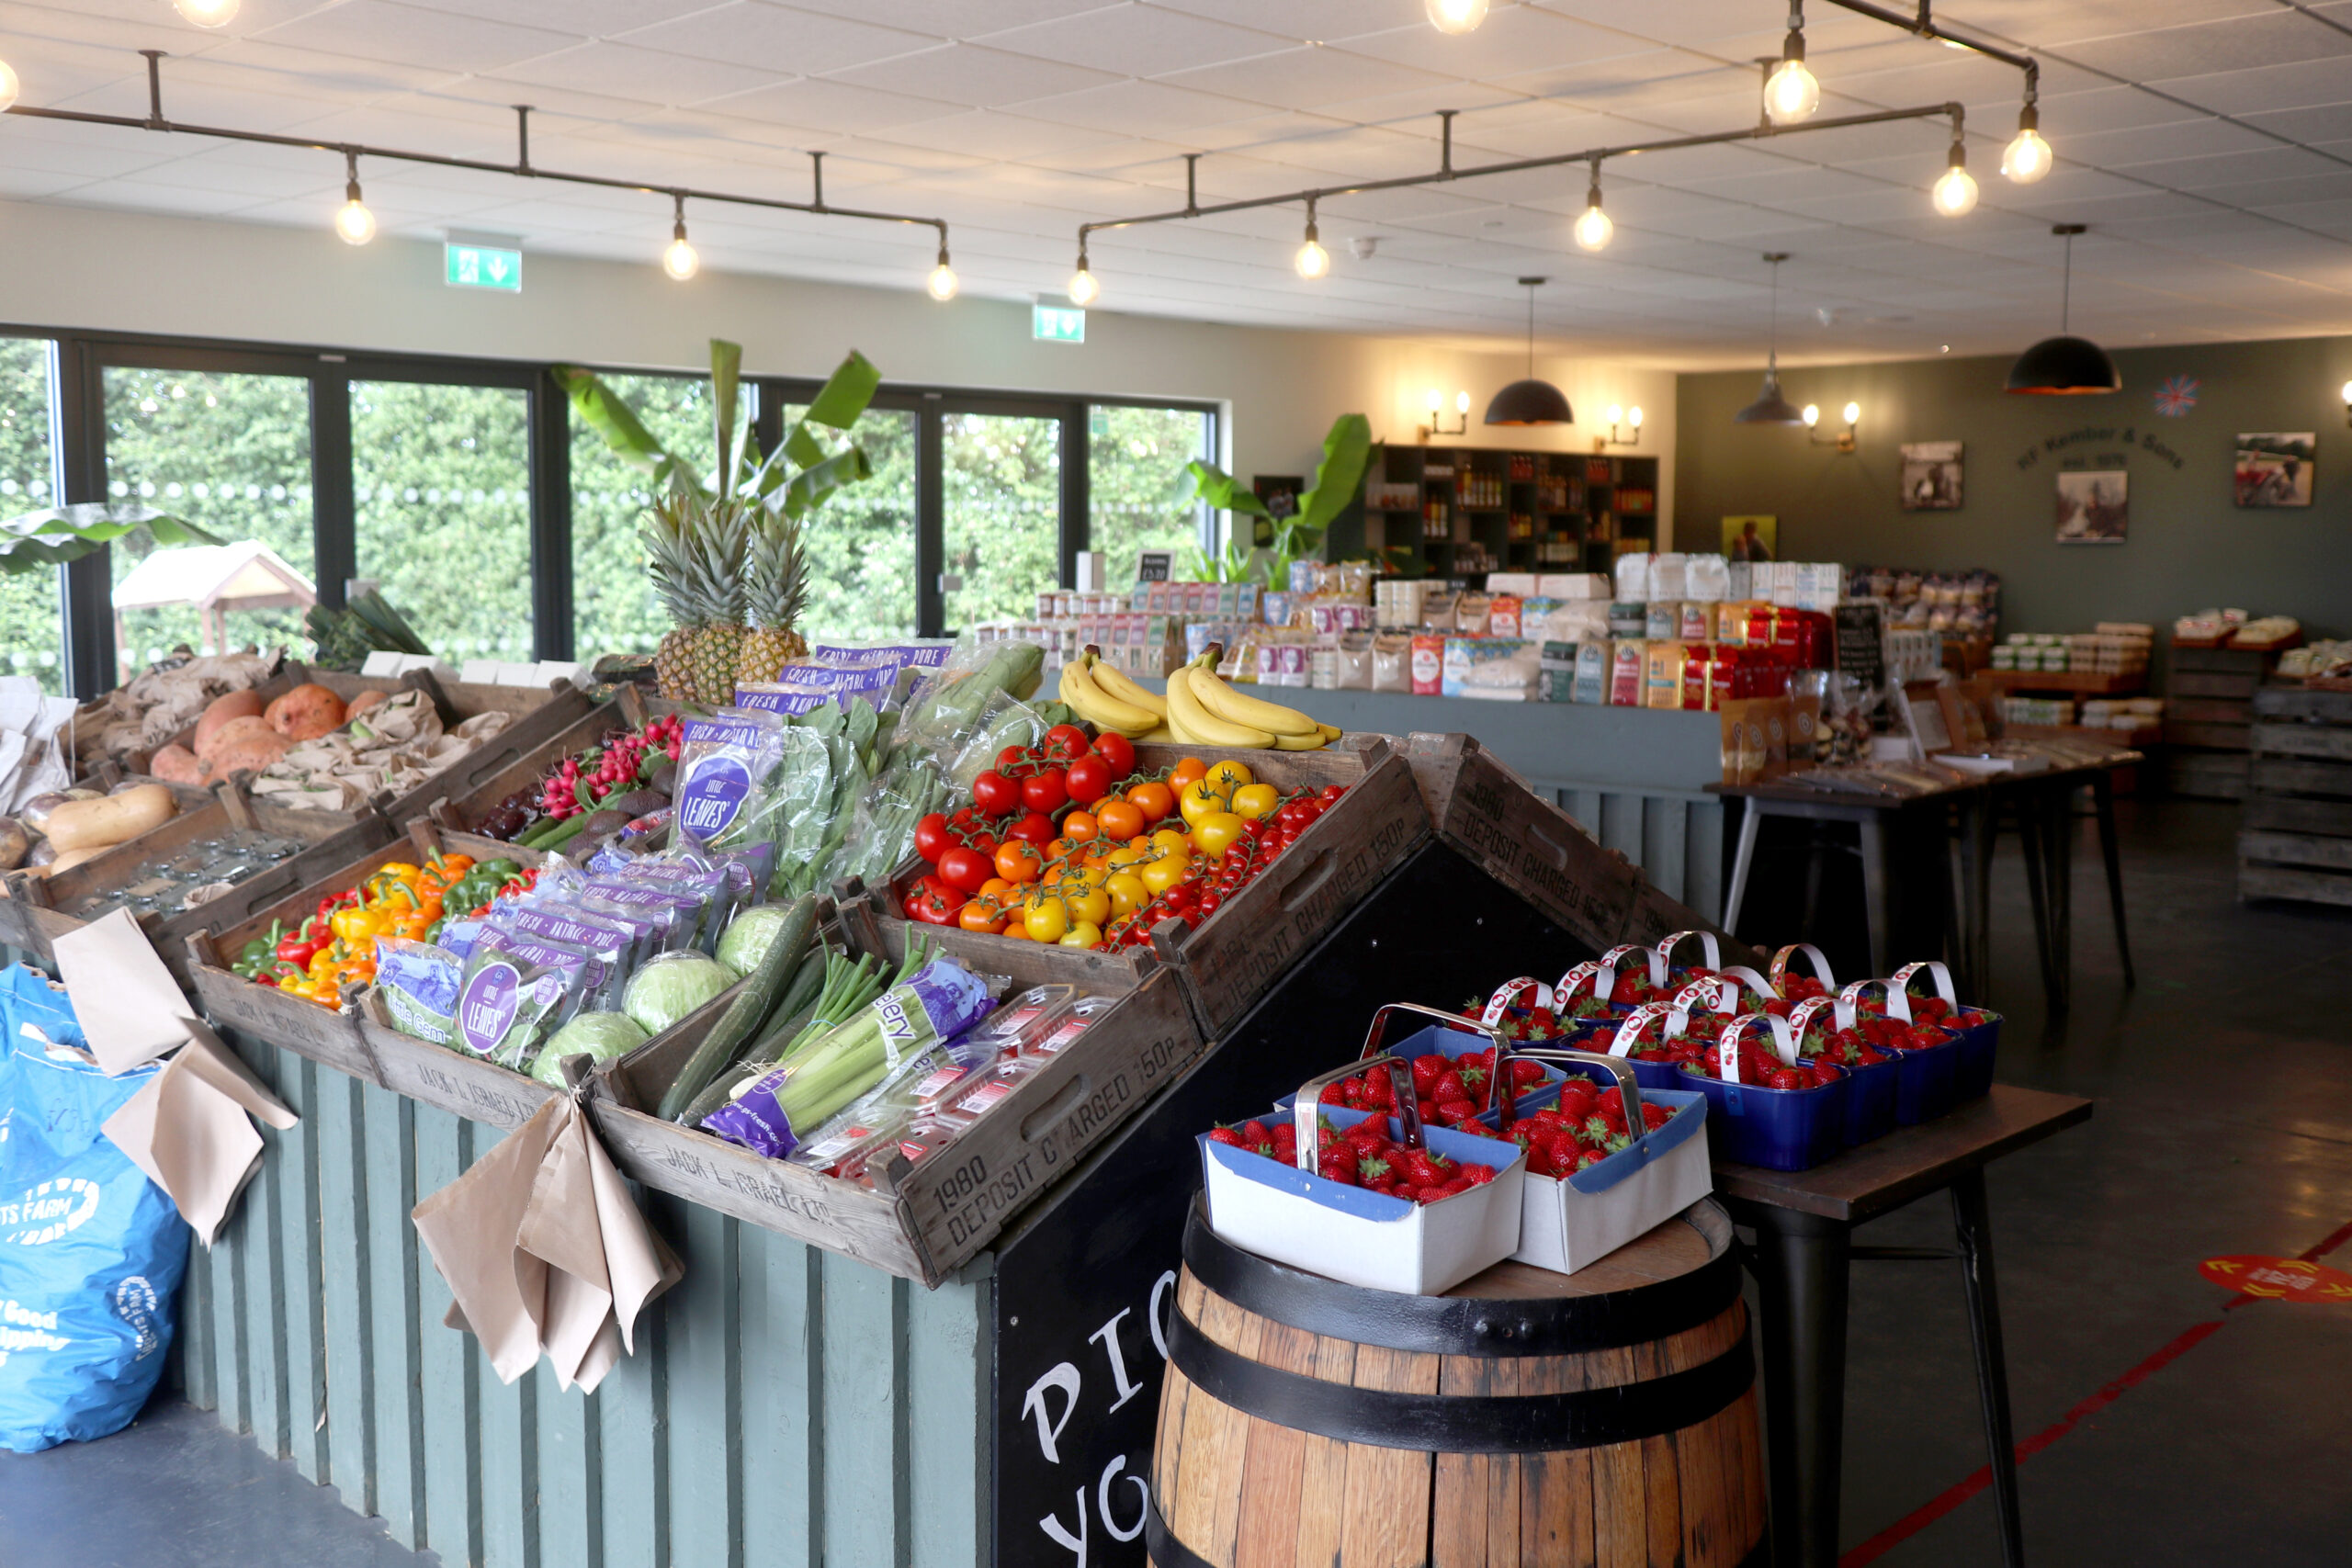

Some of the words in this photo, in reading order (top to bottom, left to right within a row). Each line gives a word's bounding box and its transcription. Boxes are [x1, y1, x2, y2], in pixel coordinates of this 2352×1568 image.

[786, 668, 818, 685] FRESH
[912, 649, 939, 665] PURE
[741, 694, 779, 710] FRESH
[705, 778, 728, 795] LITTLE
[1472, 782, 1505, 822] 1980
[683, 796, 736, 829] LEAVES
[1464, 813, 1521, 865] DEPOSIT
[1521, 852, 1580, 909] CHARGED
[1295, 854, 1368, 937] CHARGED
[388, 991, 413, 1025] Little
[413, 1013, 447, 1043] Gem
[467, 1001, 503, 1039] LEAVES
[874, 988, 917, 1040] elery
[417, 1065, 453, 1094] JACK
[468, 1081, 516, 1118] ISRAEL
[665, 1145, 708, 1179] JACK
[731, 1168, 799, 1214] ISRAEL
[933, 1155, 988, 1214] 1980
[22, 1196, 74, 1222] FARM
[946, 1153, 1038, 1248] DEPOSIT
[5, 1300, 58, 1330] Good
[0, 1325, 72, 1351] ipping
